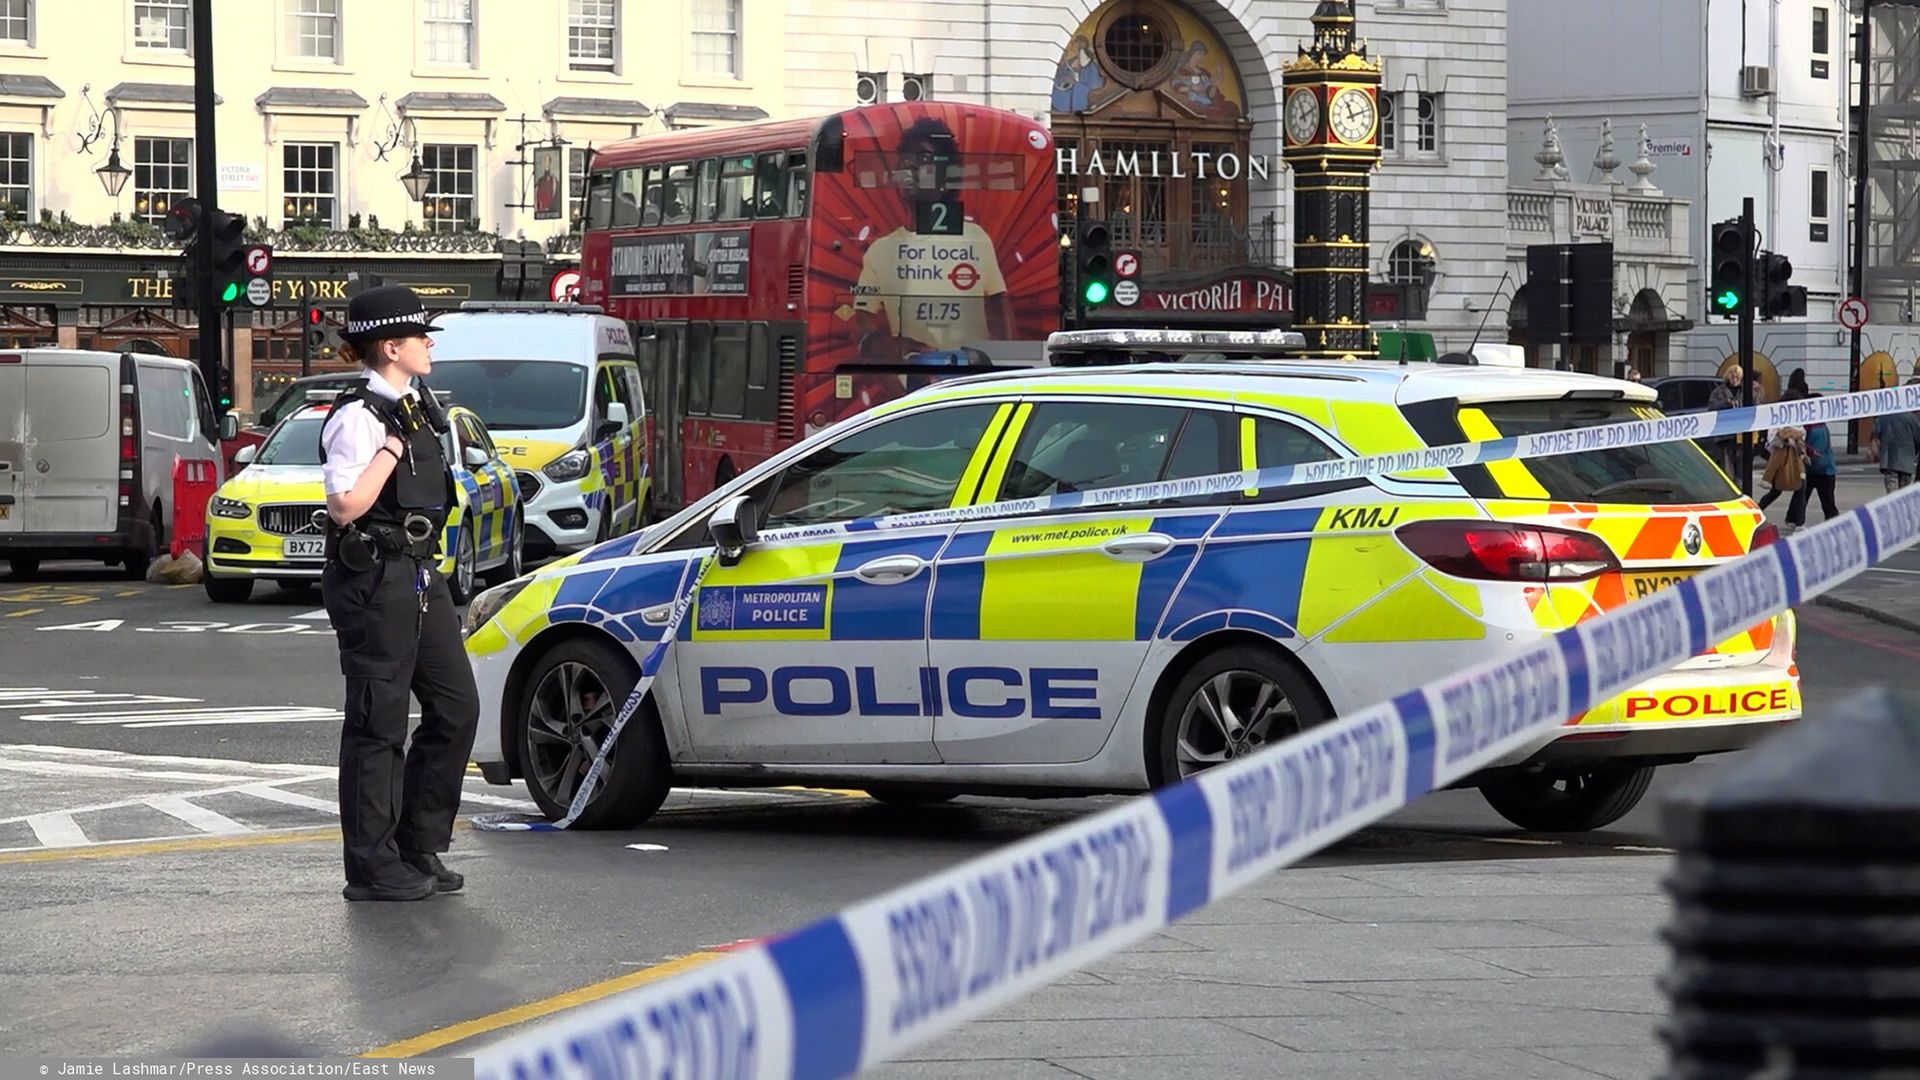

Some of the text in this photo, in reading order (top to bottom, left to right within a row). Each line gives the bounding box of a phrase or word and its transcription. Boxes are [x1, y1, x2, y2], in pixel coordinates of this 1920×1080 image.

[1056, 148, 1269, 180] HAMILTON
[1574, 198, 1612, 215] VICTORIA
[931, 203, 948, 231] 2
[1576, 215, 1609, 232] PALACE
[898, 244, 925, 260] For
[897, 265, 943, 280] think
[128, 278, 172, 298] THE
[1158, 280, 1242, 311] VICTORIA
[916, 303, 960, 321] £1.75
[1329, 507, 1400, 529] KMJ
[1012, 525, 1128, 543] www.met.police.uk
[289, 541, 323, 553] BX72
[742, 591, 821, 604] METROPOLITAN
[752, 609, 808, 623] POLICE
[700, 666, 1101, 720] POLICE
[1626, 689, 1787, 718] POLICE
